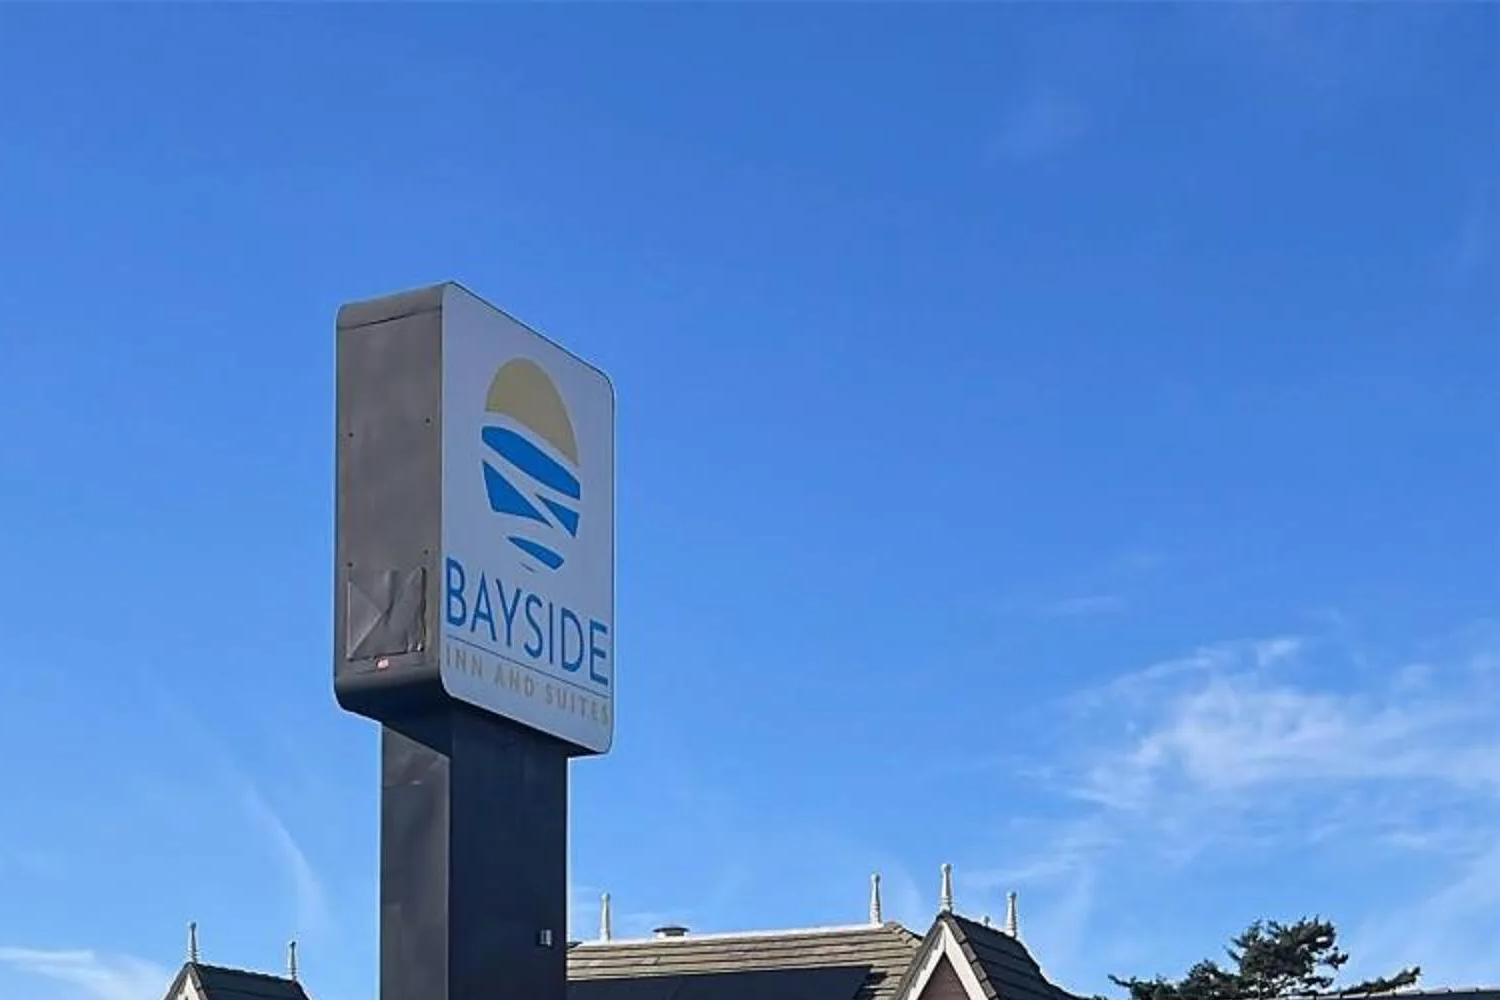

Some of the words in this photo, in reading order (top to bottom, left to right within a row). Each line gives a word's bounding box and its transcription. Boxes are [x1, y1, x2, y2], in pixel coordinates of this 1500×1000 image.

[446, 556, 609, 686] BAYSIDE
[446, 642, 483, 678] INN
[494, 664, 535, 698] AND
[545, 682, 610, 727] SUITES
